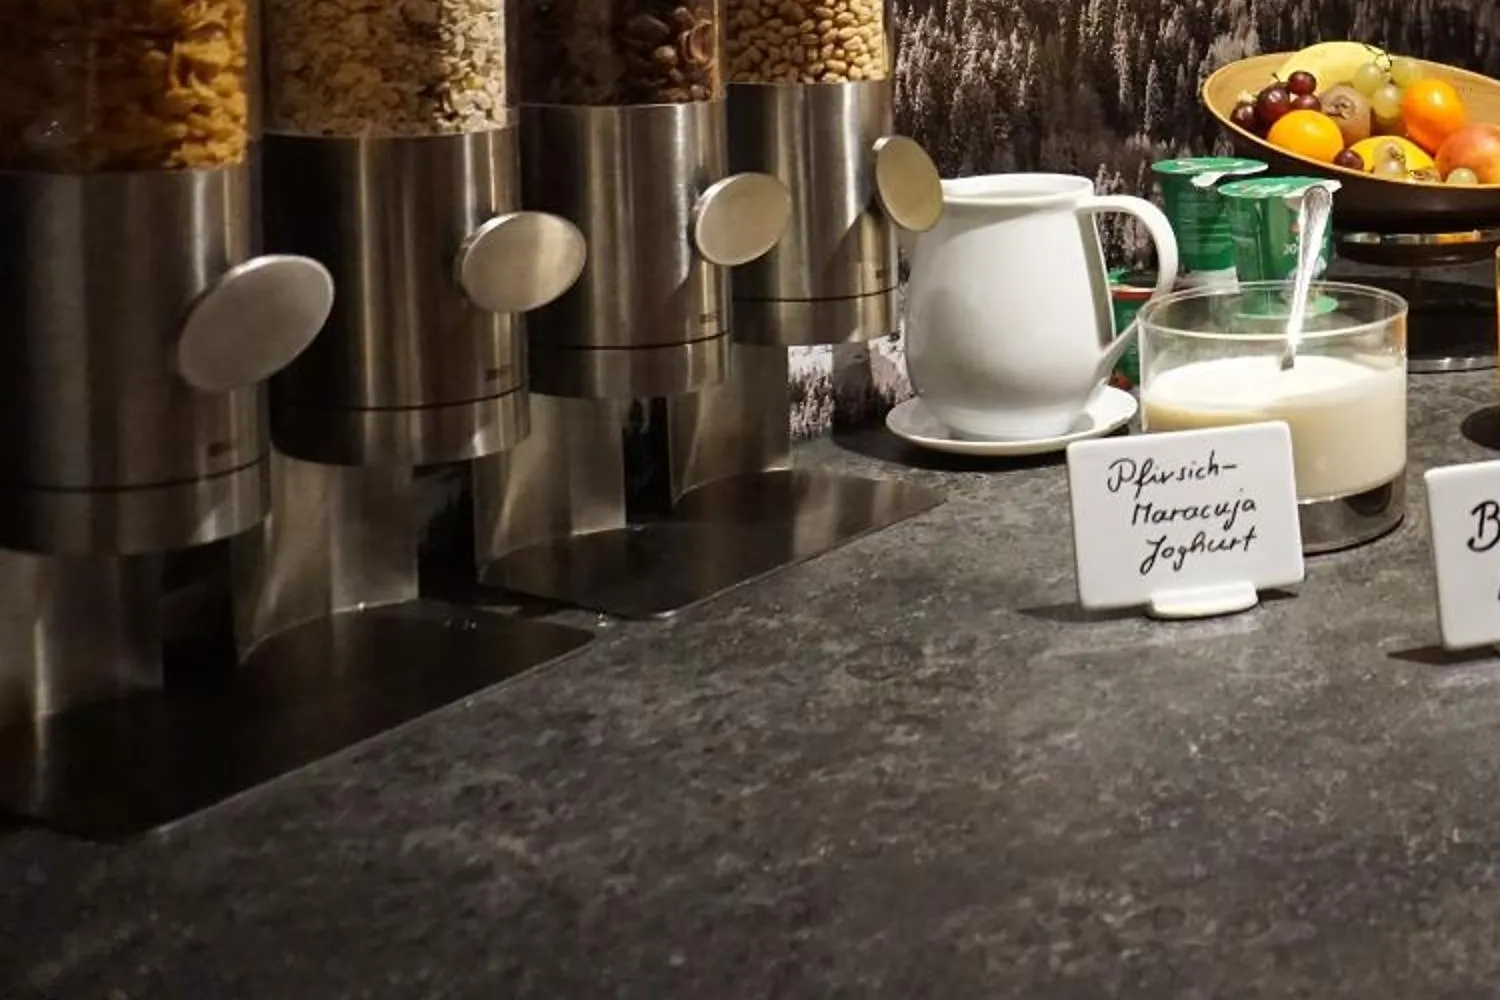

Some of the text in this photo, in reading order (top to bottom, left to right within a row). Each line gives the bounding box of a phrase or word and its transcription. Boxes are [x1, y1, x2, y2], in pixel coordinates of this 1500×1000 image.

[1107, 449, 1238, 499] Pfirsich-
[1131, 488, 1257, 531] Maracuja
[1139, 527, 1257, 576] Joghurt
